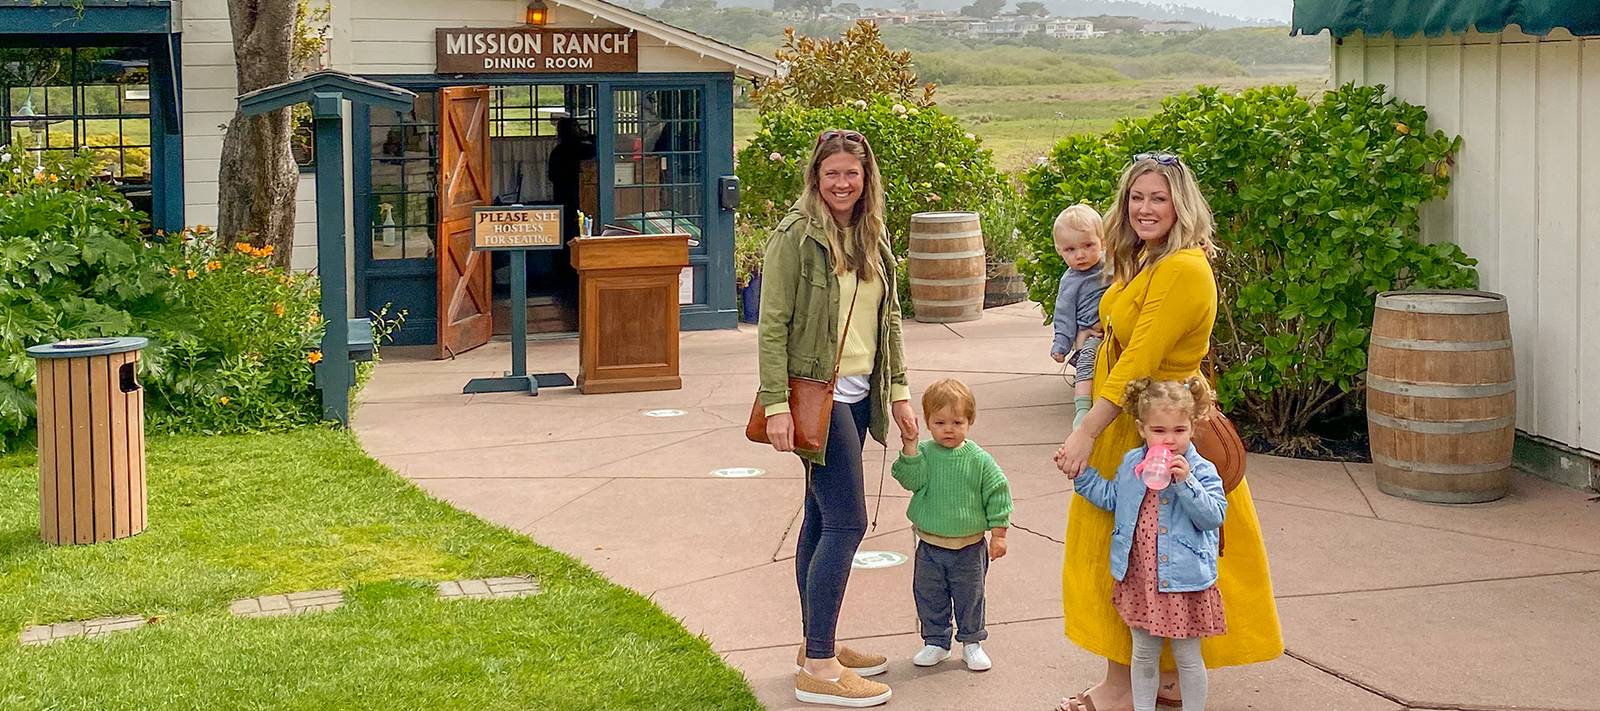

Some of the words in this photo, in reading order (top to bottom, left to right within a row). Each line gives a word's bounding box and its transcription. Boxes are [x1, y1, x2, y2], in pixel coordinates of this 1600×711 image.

[446, 33, 541, 55] MISSION
[552, 33, 629, 54] RANCH
[484, 57, 535, 69] DINING
[545, 57, 593, 69] ROOM
[479, 212, 528, 224] PLEASE
[494, 223, 544, 233] HOSTESS
[484, 235, 505, 245] FOR
[508, 234, 552, 244] SEATING
